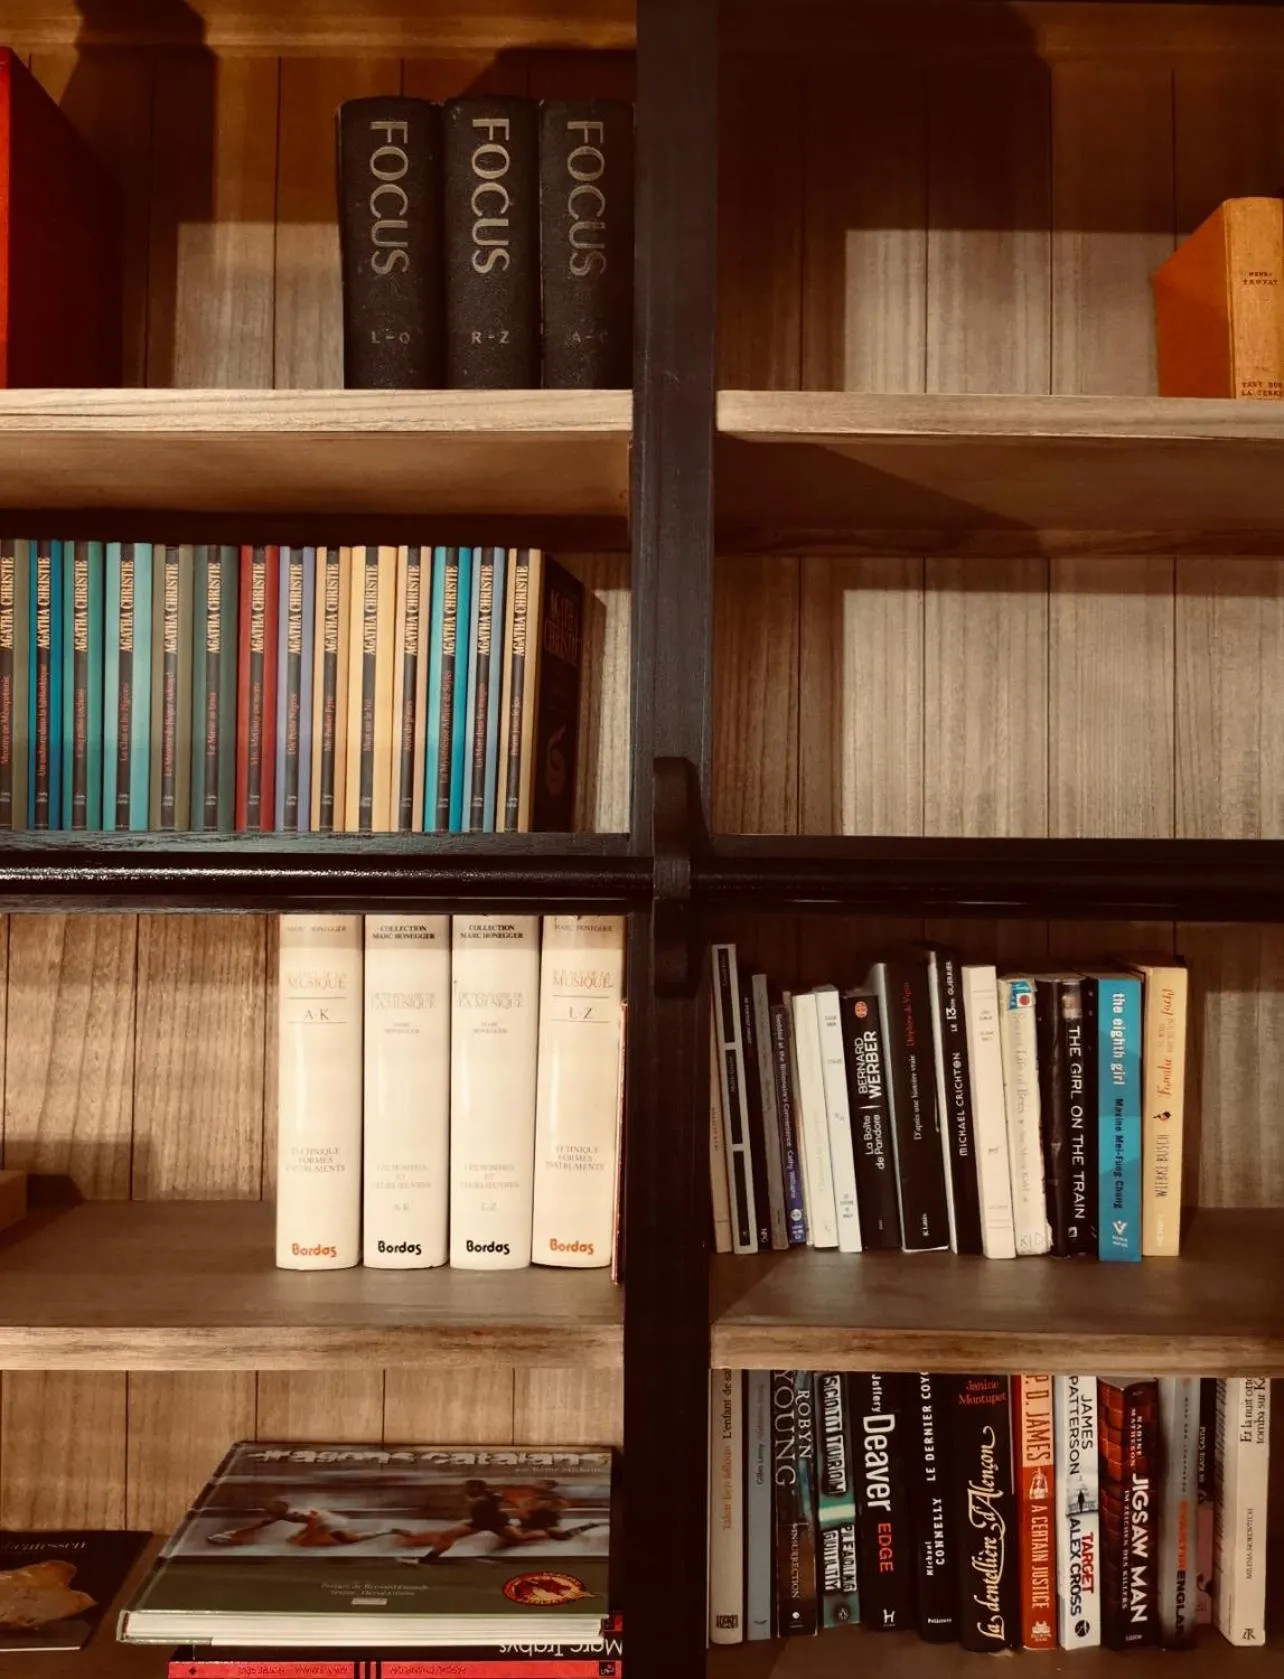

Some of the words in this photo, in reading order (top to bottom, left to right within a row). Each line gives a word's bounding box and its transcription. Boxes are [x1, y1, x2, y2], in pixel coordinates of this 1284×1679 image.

[370, 120, 409, 274] FOCUS
[471, 118, 510, 274] FOCUS
[567, 121, 606, 276] FOCUS
[471, 330, 510, 345] R-Z
[1, 557, 13, 605] CHRISTIE
[38, 558, 50, 605] CHRISTIE
[75, 561, 87, 608] CHRISTIE
[121, 561, 133, 608] CHRISTIE
[164, 564, 178, 611] CHRISTIE
[207, 563, 221, 610] CHRISTIE
[252, 563, 264, 610] CHRISTIE
[290, 564, 302, 611] CHRISTIE
[326, 564, 339, 611] CHRISTIE
[364, 565, 378, 612] CHRISTIE
[406, 565, 420, 612] CHRISTIE
[444, 566, 458, 613] CHRISTIE
[479, 565, 493, 613] CHRISTIE
[514, 566, 528, 614] CHRISTIE
[1, 609, 13, 648] AGATHA
[38, 609, 50, 648] AGATHA
[75, 612, 88, 652] AGATHA
[121, 612, 134, 652] AGATHA
[164, 615, 178, 654] AGATHA
[207, 614, 221, 654] AGATHA
[252, 614, 264, 654] AGATHA
[289, 615, 302, 654] AGATHA
[325, 615, 338, 653] AGATHA
[363, 616, 377, 655] AGATHA
[404, 616, 418, 655] AGATHA
[442, 617, 456, 656] AGATHA
[477, 616, 491, 655] AGATHA
[513, 617, 526, 656] AGATHA
[287, 979, 347, 990] MUSIQUE
[552, 976, 612, 988] MUSIQUE
[304, 1008, 330, 1021] A-K
[1113, 993, 1126, 1014] the
[951, 1024, 958, 1032] LE
[1068, 1026, 1081, 1056] THE
[1110, 1018, 1126, 1058] eighth
[855, 1038, 867, 1094] BERNARD
[864, 1031, 882, 1099] WERBER
[909, 1055, 917, 1071] vraie
[952, 1052, 964, 1107] CRICHTON
[1069, 1063, 1082, 1100] GIRL
[1110, 1063, 1126, 1085] girl
[909, 1073, 919, 1098] histoire
[863, 1115, 872, 1140] Boîte
[872, 1114, 883, 1154] Pandore
[913, 1114, 923, 1140] D'après
[956, 1110, 968, 1156] MICHAEL
[1070, 1106, 1083, 1129] ON
[1114, 1098, 1124, 1131] Maxine
[865, 1142, 873, 1154] La
[875, 1157, 885, 1169] de
[1072, 1134, 1084, 1166] THE
[1155, 1134, 1169, 1162] BUSCH
[1072, 1171, 1085, 1219] TRAIN
[1113, 1180, 1124, 1209] Chang
[291, 1243, 337, 1257] Bordas
[378, 1240, 422, 1255] Bordas
[466, 1240, 510, 1255] Bordas
[549, 1238, 594, 1255] Bordas
[722, 1383, 731, 1396] de
[824, 1375, 842, 1432] SCOTT
[871, 1374, 882, 1412] Jeffery
[1026, 1390, 1049, 1405] D.
[1244, 1399, 1253, 1418] nuit
[1257, 1393, 1265, 1409] sur
[721, 1399, 732, 1440] L'enfant
[774, 1370, 796, 1487] YOUNG
[795, 1389, 812, 1459] ROBYN
[921, 1405, 935, 1461] DERNIER
[1026, 1412, 1050, 1462] JAMES
[1069, 1376, 1080, 1475] PATTERSON
[1081, 1395, 1093, 1449] JAMES
[1129, 1408, 1137, 1467] MATHESON
[1240, 1431, 1252, 1442] Et
[1254, 1411, 1265, 1444] tomba
[863, 1414, 895, 1512] Deaver
[925, 1467, 936, 1481] LE
[967, 1426, 1006, 1530] d'Alençon
[1124, 1490, 1130, 1502] IM
[1132, 1473, 1149, 1558] JIGSAW
[878, 1522, 894, 1572] EDGE
[932, 1498, 945, 1565] CONNELLY
[1031, 1516, 1048, 1561] CERTAIN
[1070, 1518, 1081, 1560] ALEX
[791, 1529, 800, 1598] INSURRECTION
[824, 1530, 841, 1590] GUILTY
[841, 1525, 856, 1592] PLEADING
[924, 1541, 934, 1576] Michael
[971, 1536, 1004, 1612] dentellière
[1082, 1532, 1094, 1593] TARGET
[1031, 1566, 1049, 1608] JUSTICE
[1070, 1563, 1081, 1616] CROSS
[1130, 1566, 1148, 1623] MAN
[976, 1615, 1005, 1641] La
